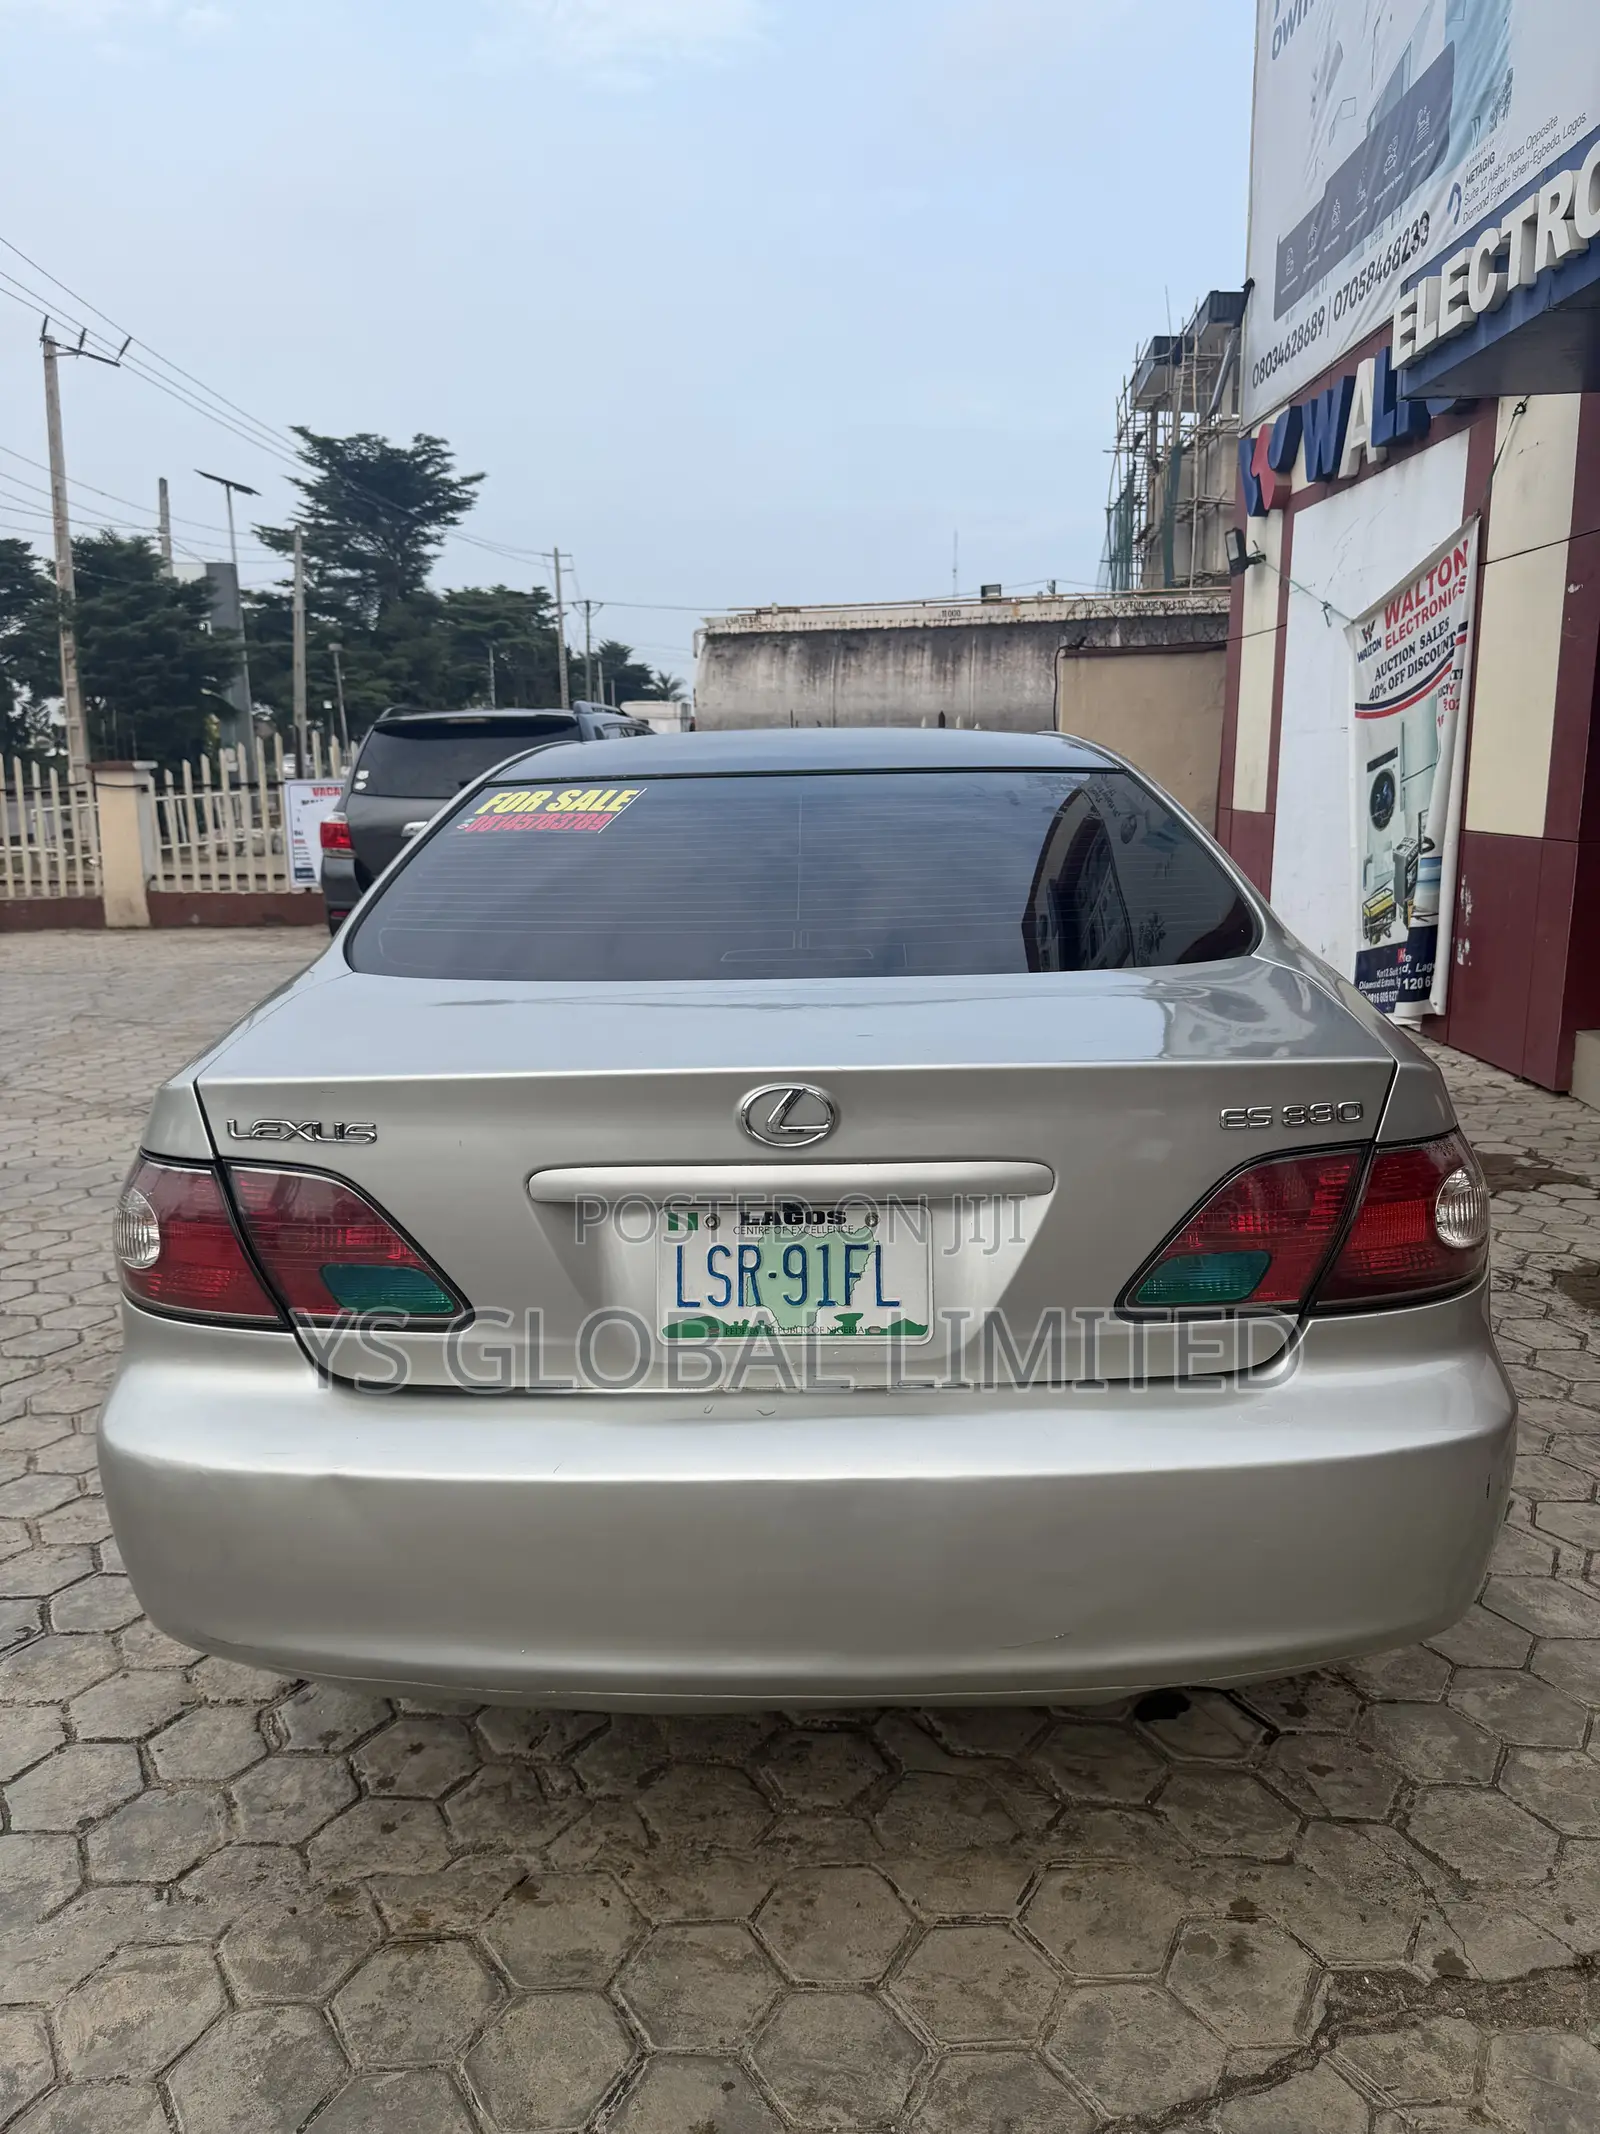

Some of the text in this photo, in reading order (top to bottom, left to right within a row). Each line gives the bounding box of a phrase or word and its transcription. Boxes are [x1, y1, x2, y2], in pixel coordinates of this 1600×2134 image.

[1507, 145, 1525, 168] Plaza
[1526, 115, 1559, 149] Opposite
[1333, 210, 1431, 322] 07058468233
[1385, 539, 1469, 630] WALTON
[1385, 575, 1467, 651] ELECTRONICS
[1369, 681, 1388, 701] 40%
[1388, 668, 1406, 691] OFF
[1407, 631, 1457, 678] DISCOUNT
[1375, 617, 1450, 681] AUCTION SALES
[474, 789, 640, 815] FOR SALE
[226, 1118, 378, 1145] LEXUS
[1219, 1101, 1364, 1131] ES 330
[732, 1225, 854, 1235] CENTRE OF EXCELLENCE
[739, 1210, 847, 1225] LAGOS
[725, 1325, 865, 1336] FEDERAL REPUBLIC OF NIGERIA
